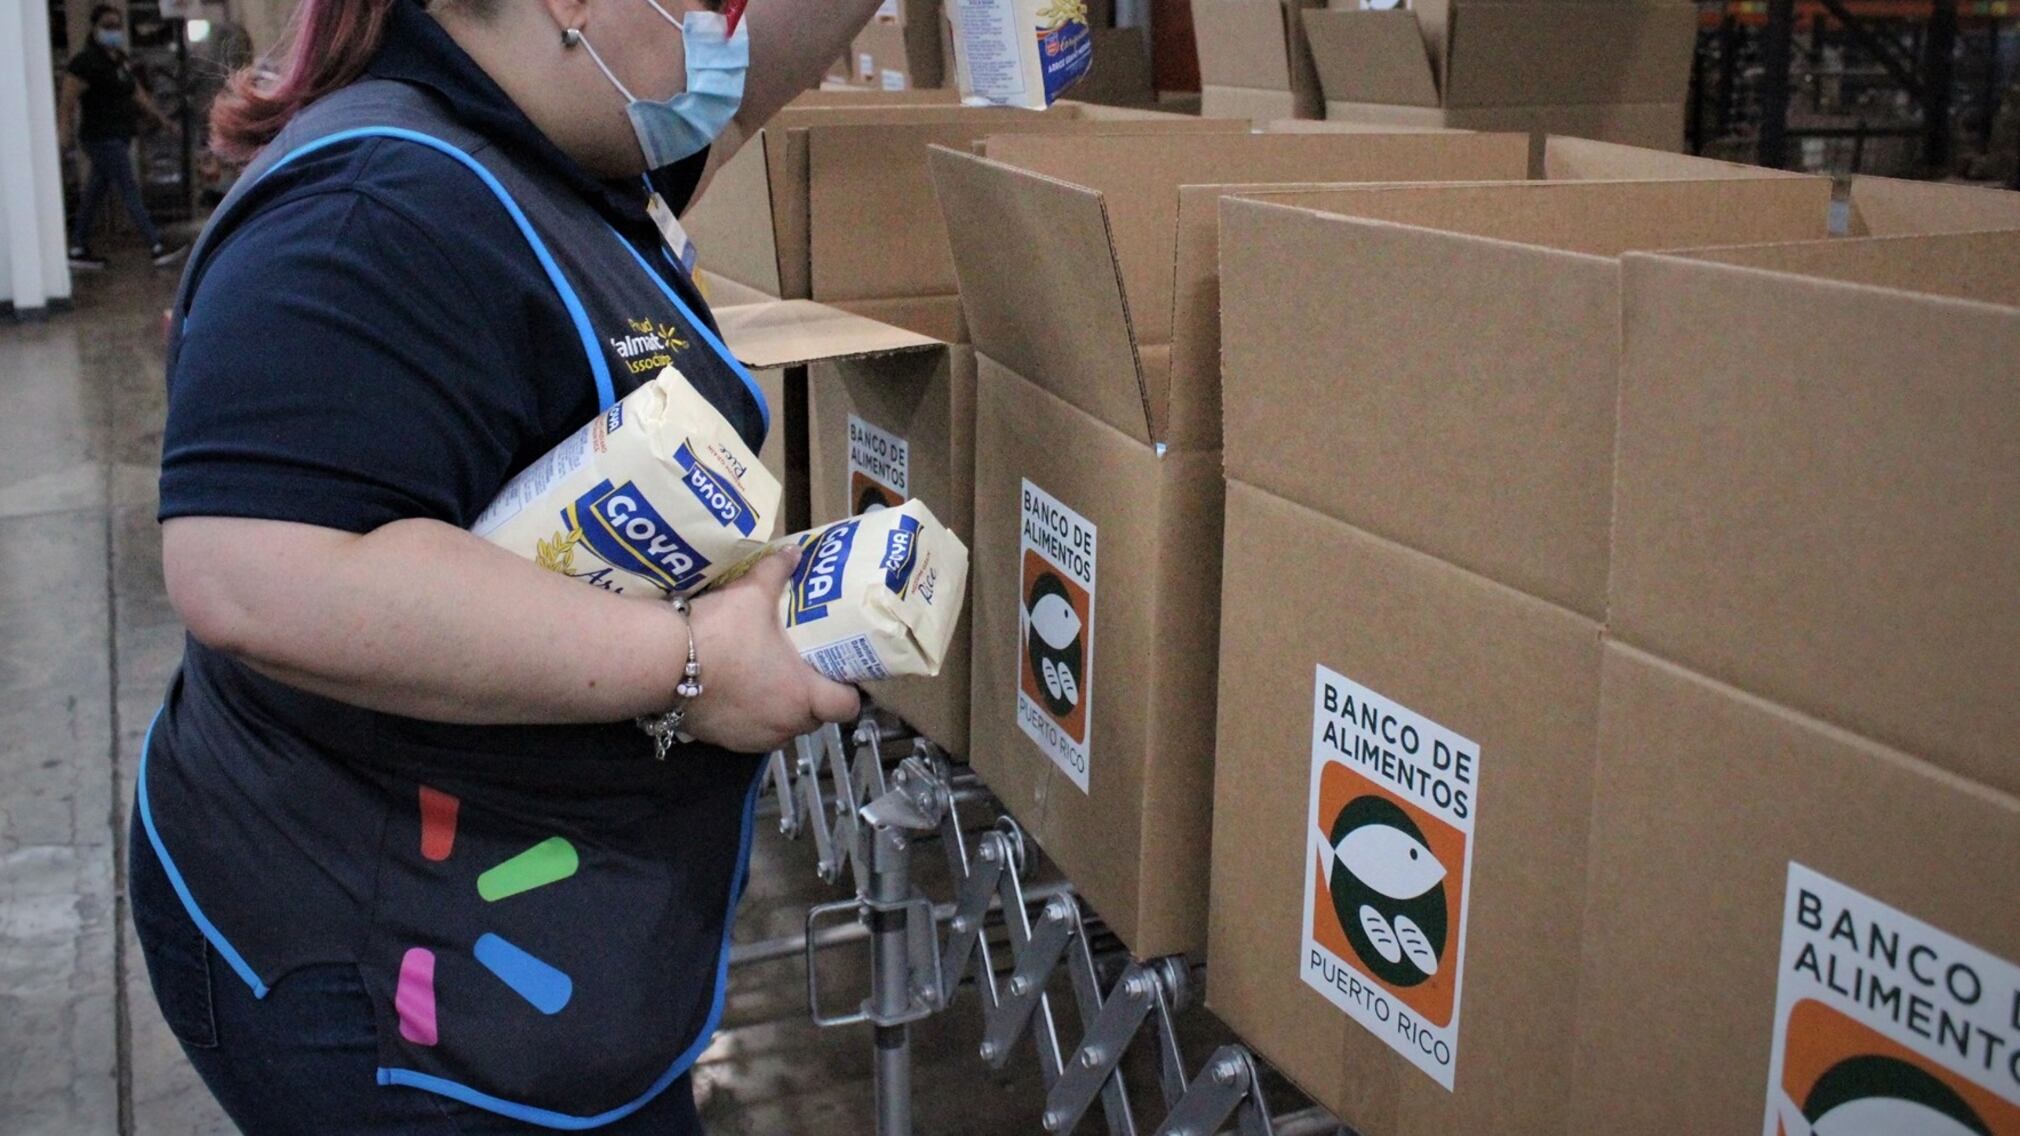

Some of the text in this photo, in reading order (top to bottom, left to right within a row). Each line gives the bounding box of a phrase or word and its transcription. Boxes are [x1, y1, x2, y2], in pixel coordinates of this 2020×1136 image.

[718, 443, 747, 478] Rice
[850, 424, 905, 467] BANCO DE
[851, 447, 905, 489] ALIMENTOS
[691, 469, 736, 520] GOYA
[1024, 490, 1092, 556] BANCO DE
[606, 495, 694, 575] GOYA
[808, 527, 849, 600] GOYA
[1023, 517, 1091, 584] ALIMENTOS
[917, 567, 937, 606] Rice
[1019, 696, 1085, 775] PUERTO RICO
[1324, 683, 1471, 785] BANCO DE
[1323, 720, 1469, 819] ALIMENTOS
[1797, 888, 1982, 1006] BANCO
[1310, 949, 1450, 1066] PUERTO RICO
